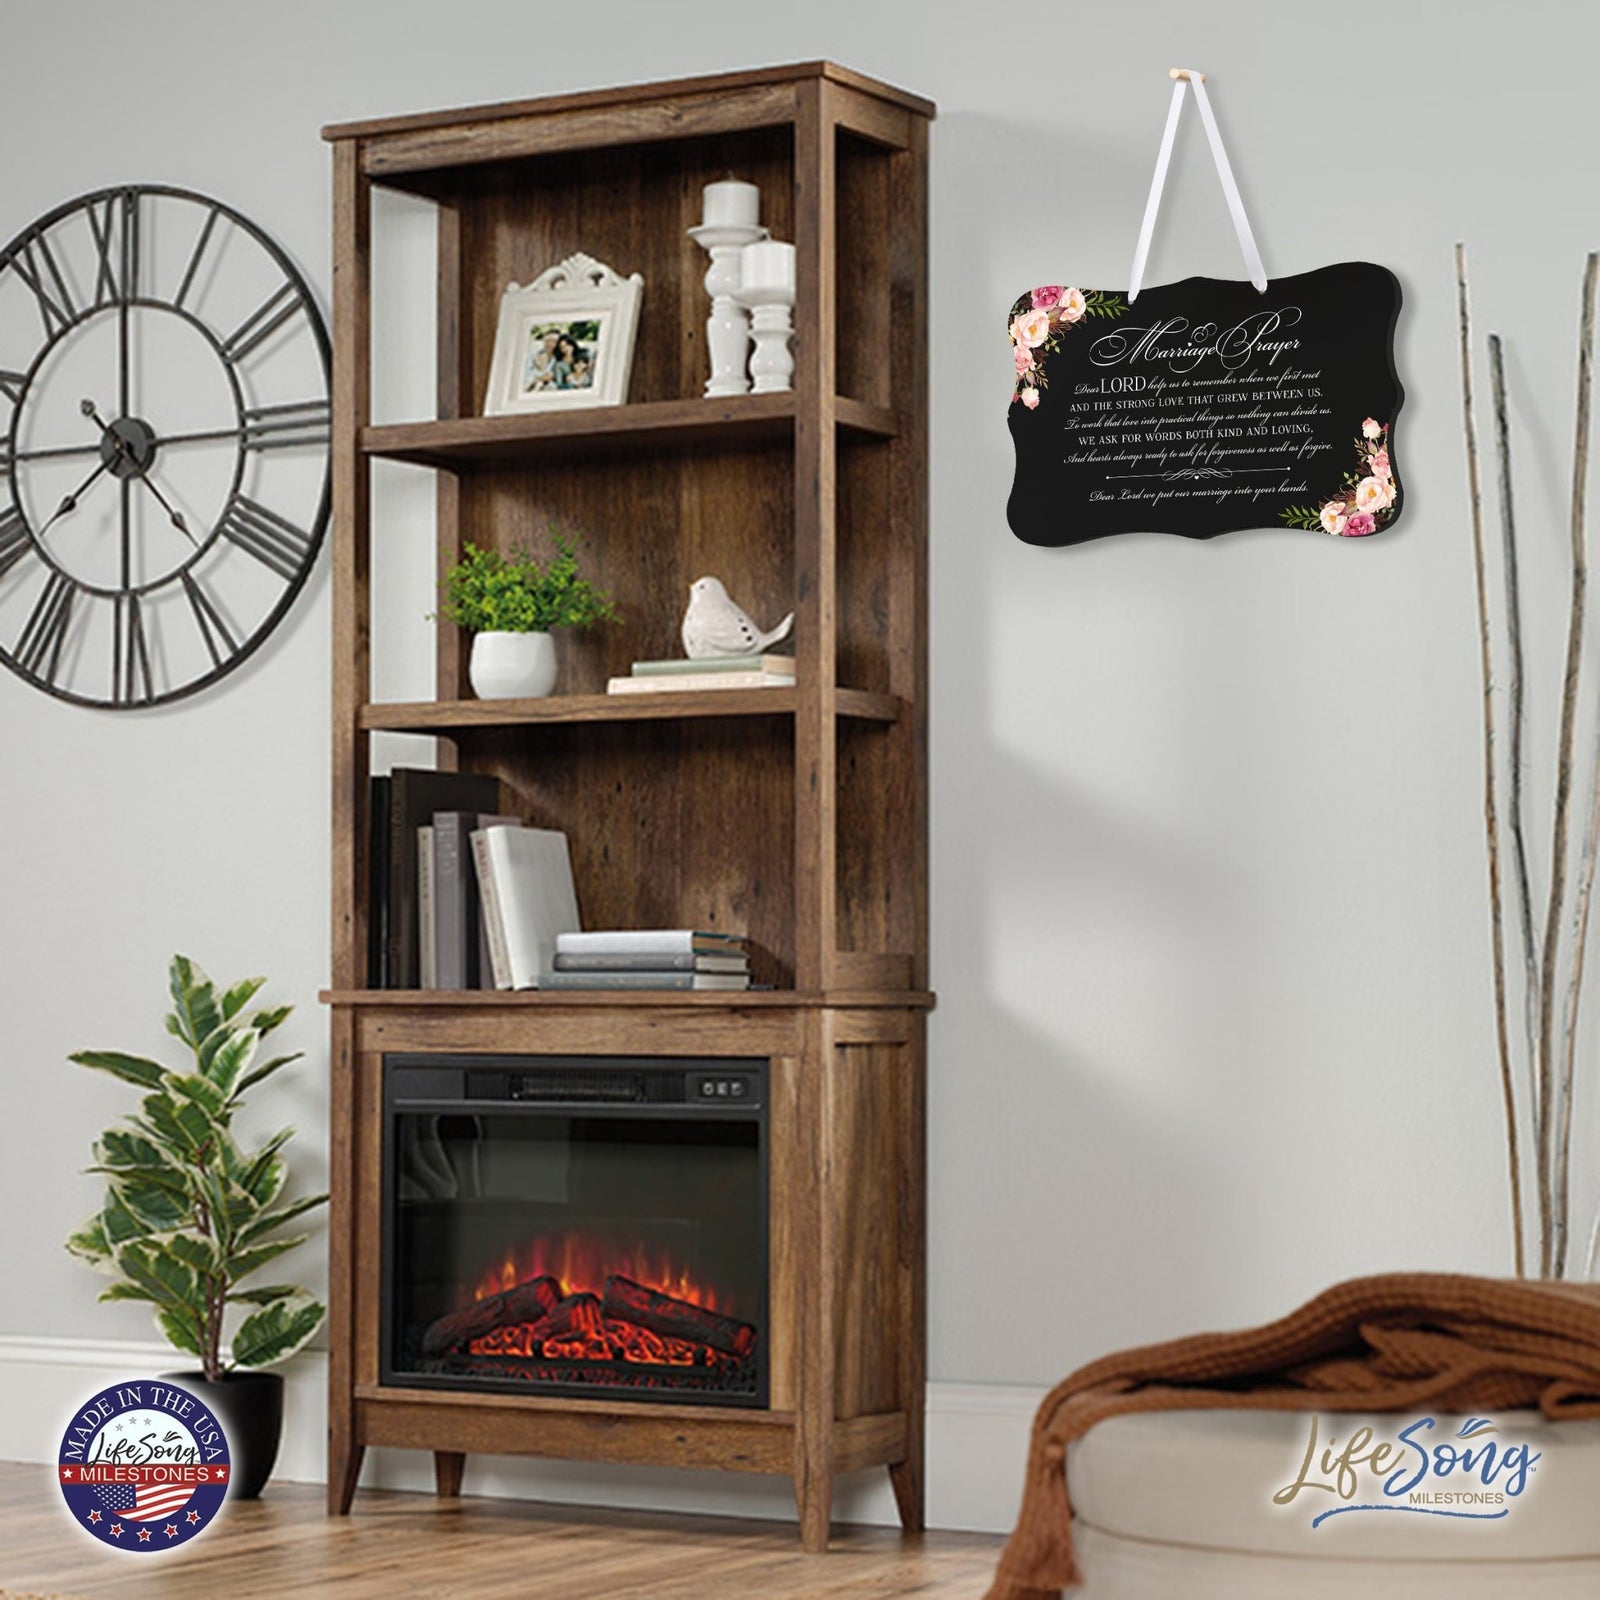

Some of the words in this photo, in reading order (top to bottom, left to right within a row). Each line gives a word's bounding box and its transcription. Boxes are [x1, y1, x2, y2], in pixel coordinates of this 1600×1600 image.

[1089, 316, 1217, 374] Marriage
[1215, 306, 1302, 370] Prayer
[1073, 383, 1100, 395] Dear
[1100, 375, 1146, 394] LORD
[1147, 375, 1167, 397] help
[1181, 379, 1191, 387] to
[1192, 370, 1237, 387] remember
[1238, 368, 1264, 384] when
[1275, 366, 1303, 390] first
[1301, 369, 1322, 380] met
[1069, 402, 1090, 413] AND
[1094, 401, 1113, 412] THE
[1116, 399, 1155, 410] STRONG
[1158, 396, 1185, 408] LOVE
[1186, 394, 1214, 405] THAT
[1217, 392, 1249, 404] GREW
[1252, 389, 1304, 401] BETWEEN
[1307, 387, 1324, 398] US.
[1064, 416, 1081, 430] To
[1081, 413, 1103, 428] work
[1103, 413, 1122, 427] that
[1122, 415, 1139, 426] love
[1140, 416, 1158, 425] into
[1154, 411, 1199, 433] practical
[1197, 407, 1224, 429] things
[1237, 404, 1272, 427] nothing
[1290, 403, 1319, 416] divide
[1078, 436, 1096, 446] WE
[1098, 434, 1119, 445] ASK
[1121, 433, 1142, 444] FOR
[1145, 431, 1182, 442] WORDS
[1185, 429, 1214, 440] BOTH
[1217, 427, 1243, 438] KIND
[1246, 426, 1269, 437] AND
[1063, 451, 1090, 464] And
[1086, 448, 1112, 462] hearts
[1112, 449, 1143, 468] always
[1144, 447, 1168, 467] ready
[1168, 449, 1178, 458] to
[1178, 442, 1199, 457] ask
[1191, 442, 1208, 465] for
[1205, 441, 1255, 464] forgiveness
[1268, 440, 1292, 453] well
[1297, 436, 1334, 460] forgive.
[1088, 490, 1115, 502] Dear
[1117, 488, 1145, 501] Lord
[1152, 489, 1176, 507] put
[1174, 490, 1191, 498] our
[1191, 487, 1233, 504] marriage
[1234, 485, 1253, 495] into
[1252, 486, 1277, 503] your
[1276, 478, 1309, 493] hands.
